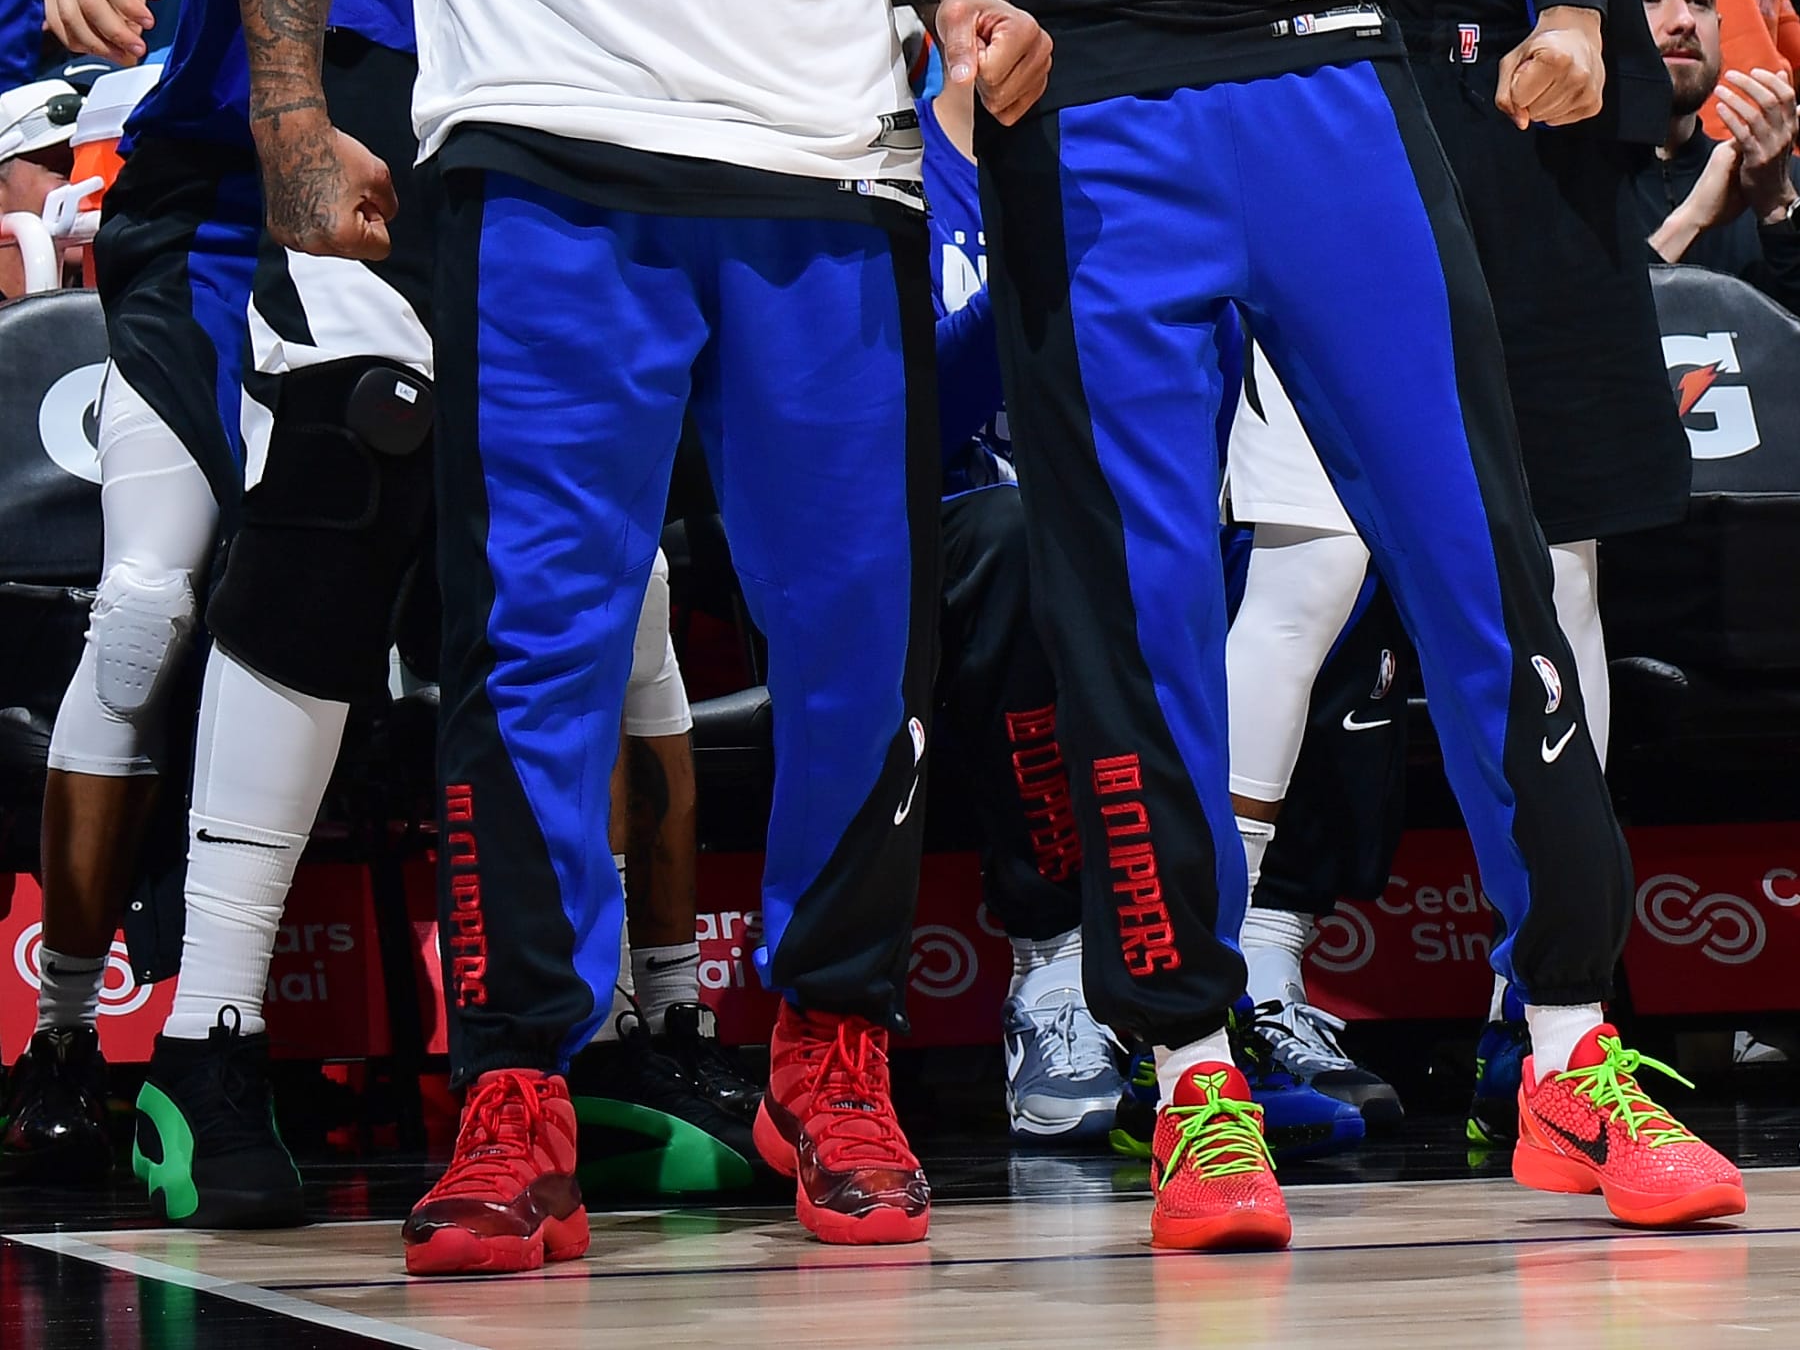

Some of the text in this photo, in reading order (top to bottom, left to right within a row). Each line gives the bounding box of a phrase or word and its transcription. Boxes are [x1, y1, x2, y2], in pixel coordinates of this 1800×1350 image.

[1092, 752, 1183, 977] LA CLIPPERS
[1411, 921, 1492, 962] Sin
